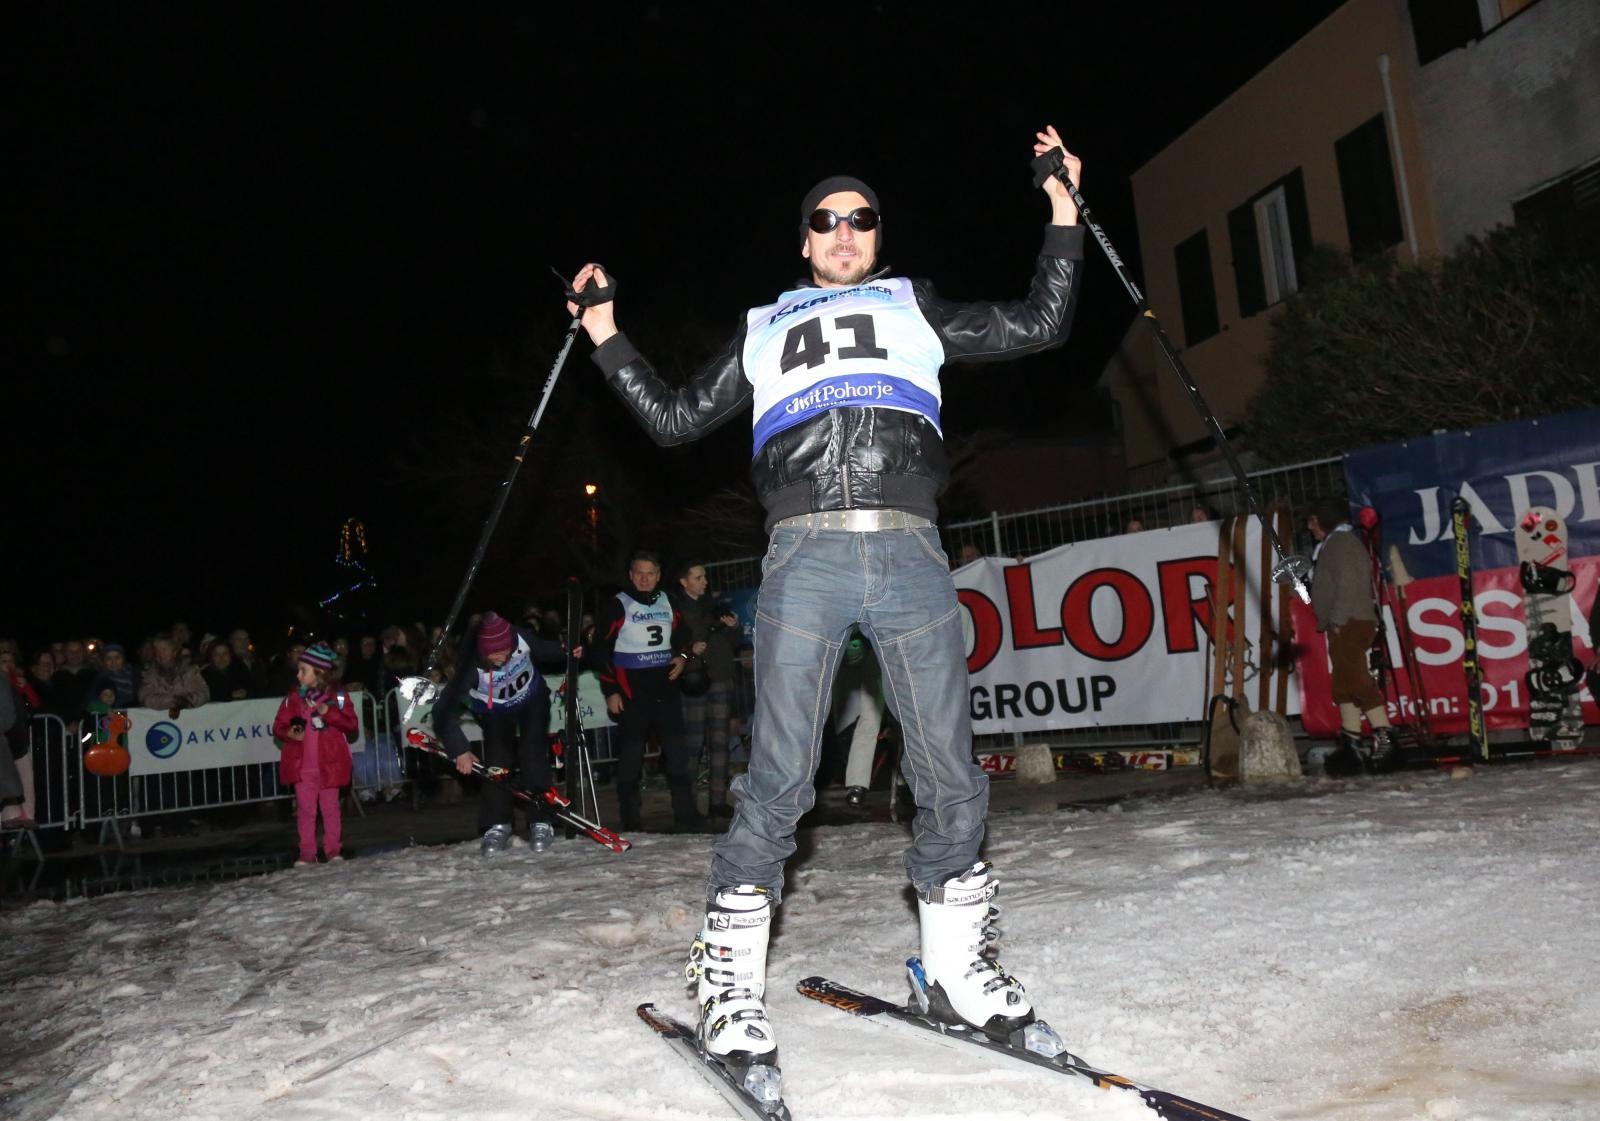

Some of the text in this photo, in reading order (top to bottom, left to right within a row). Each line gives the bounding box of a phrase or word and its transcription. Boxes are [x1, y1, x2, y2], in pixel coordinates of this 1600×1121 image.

[780, 314, 888, 375] 41
[646, 625, 664, 646] 3
[970, 675, 1117, 720] GROUP
